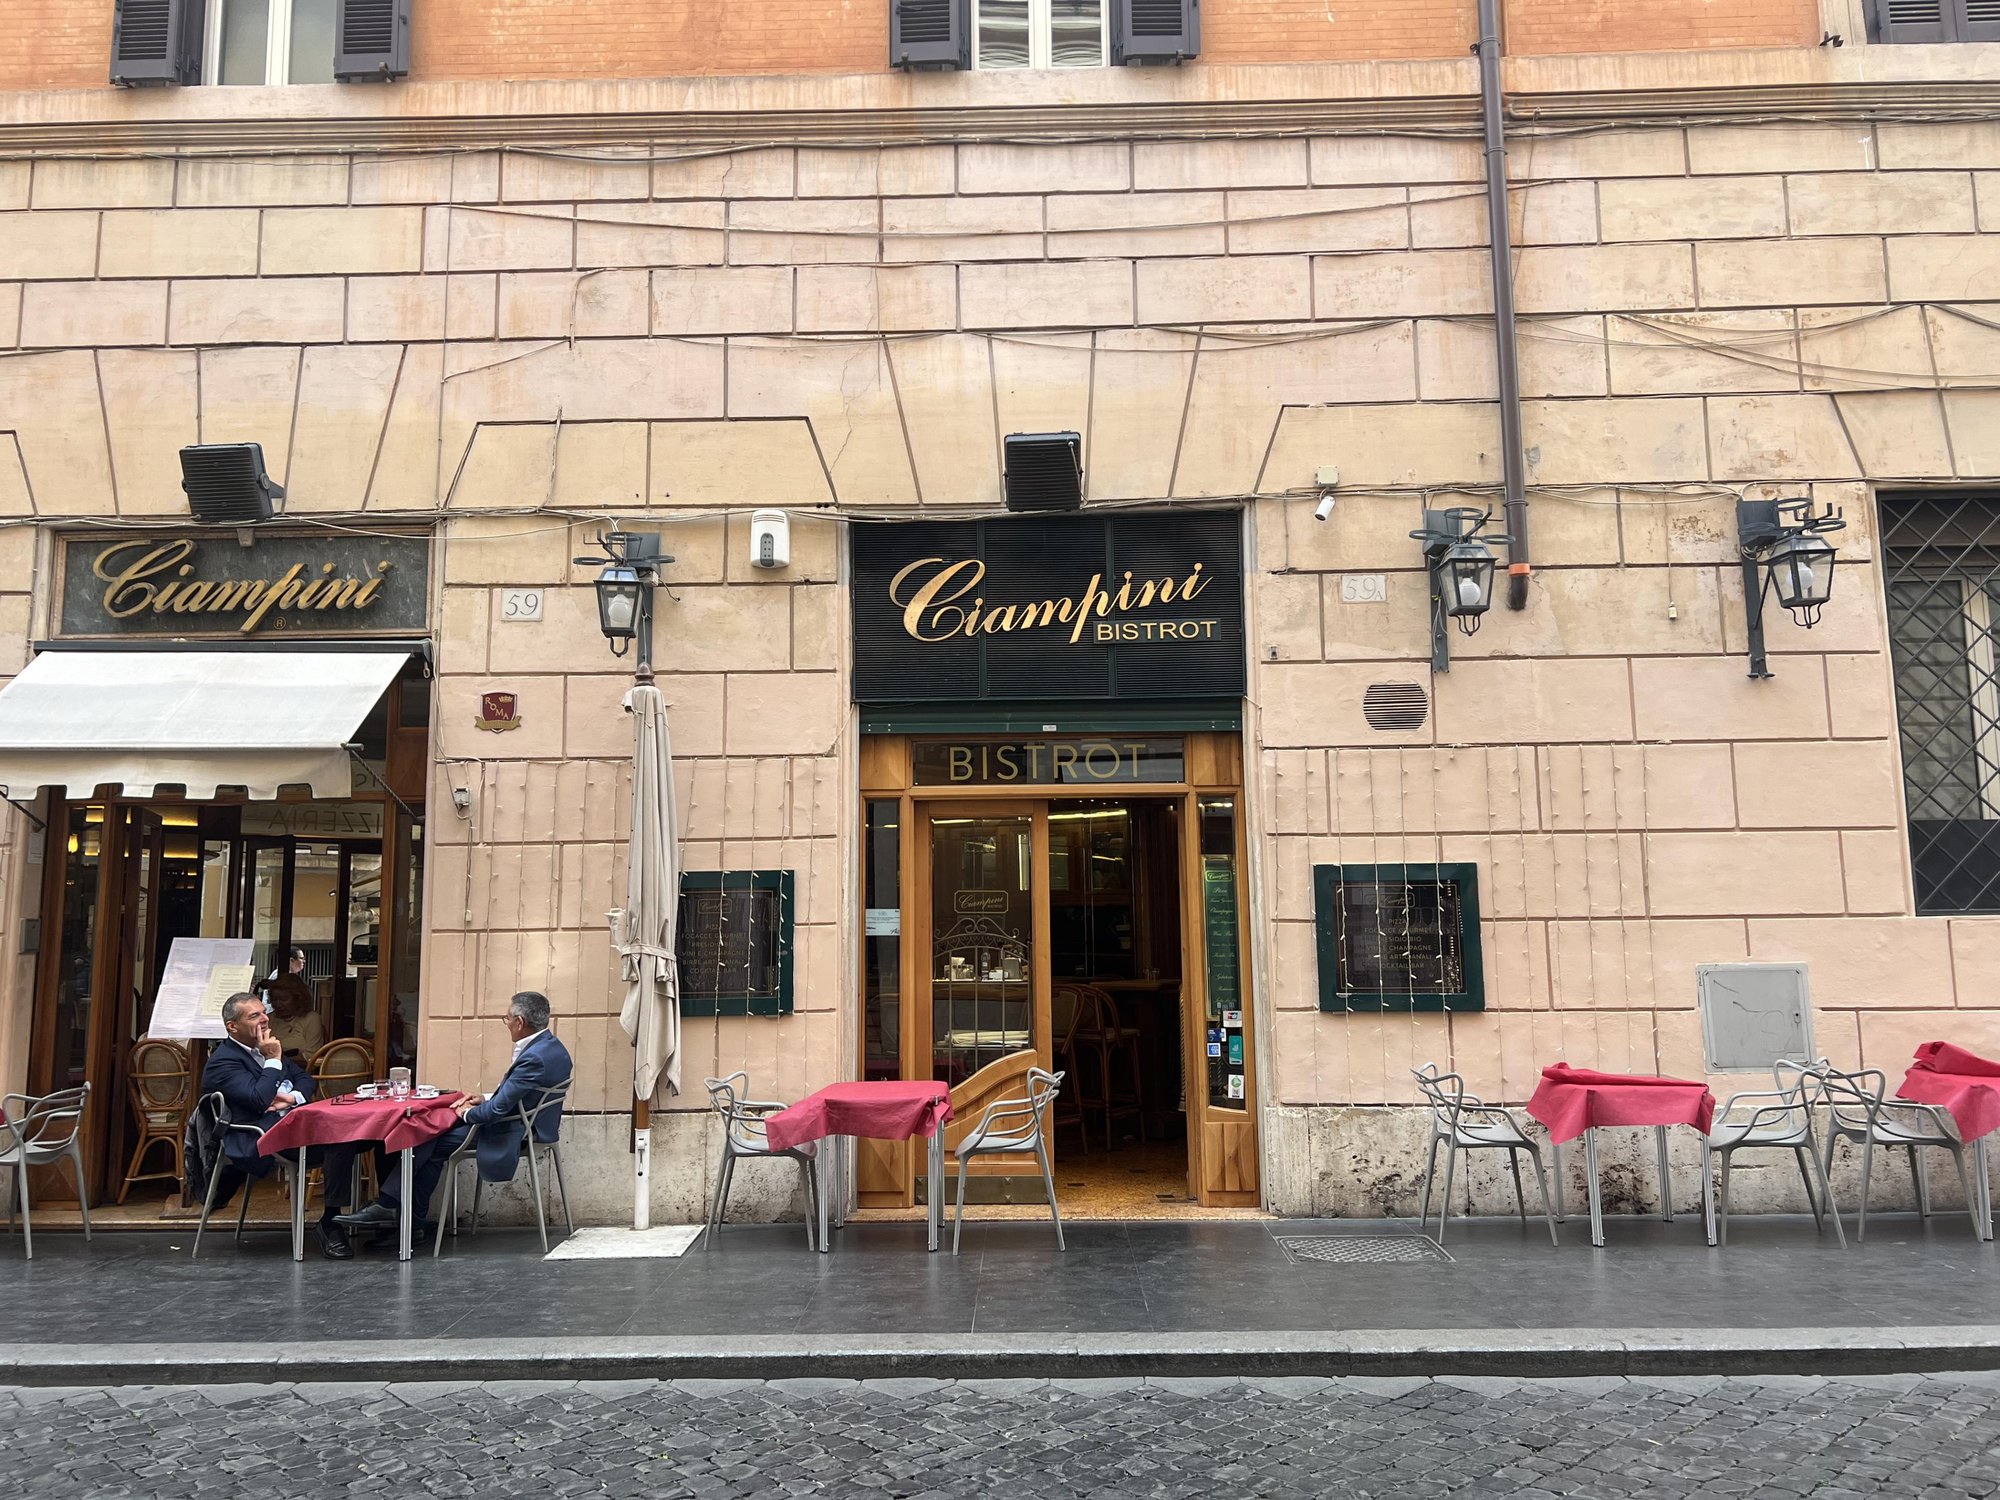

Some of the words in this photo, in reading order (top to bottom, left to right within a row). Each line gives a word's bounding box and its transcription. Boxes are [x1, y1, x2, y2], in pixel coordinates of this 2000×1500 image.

[93, 539, 392, 632] Ciampini
[889, 557, 1214, 644] Ciampini
[505, 593, 539, 616] 59
[1097, 620, 1217, 642] BISTROT
[484, 697, 510, 720] ROMA
[949, 743, 1147, 782] BISTROT
